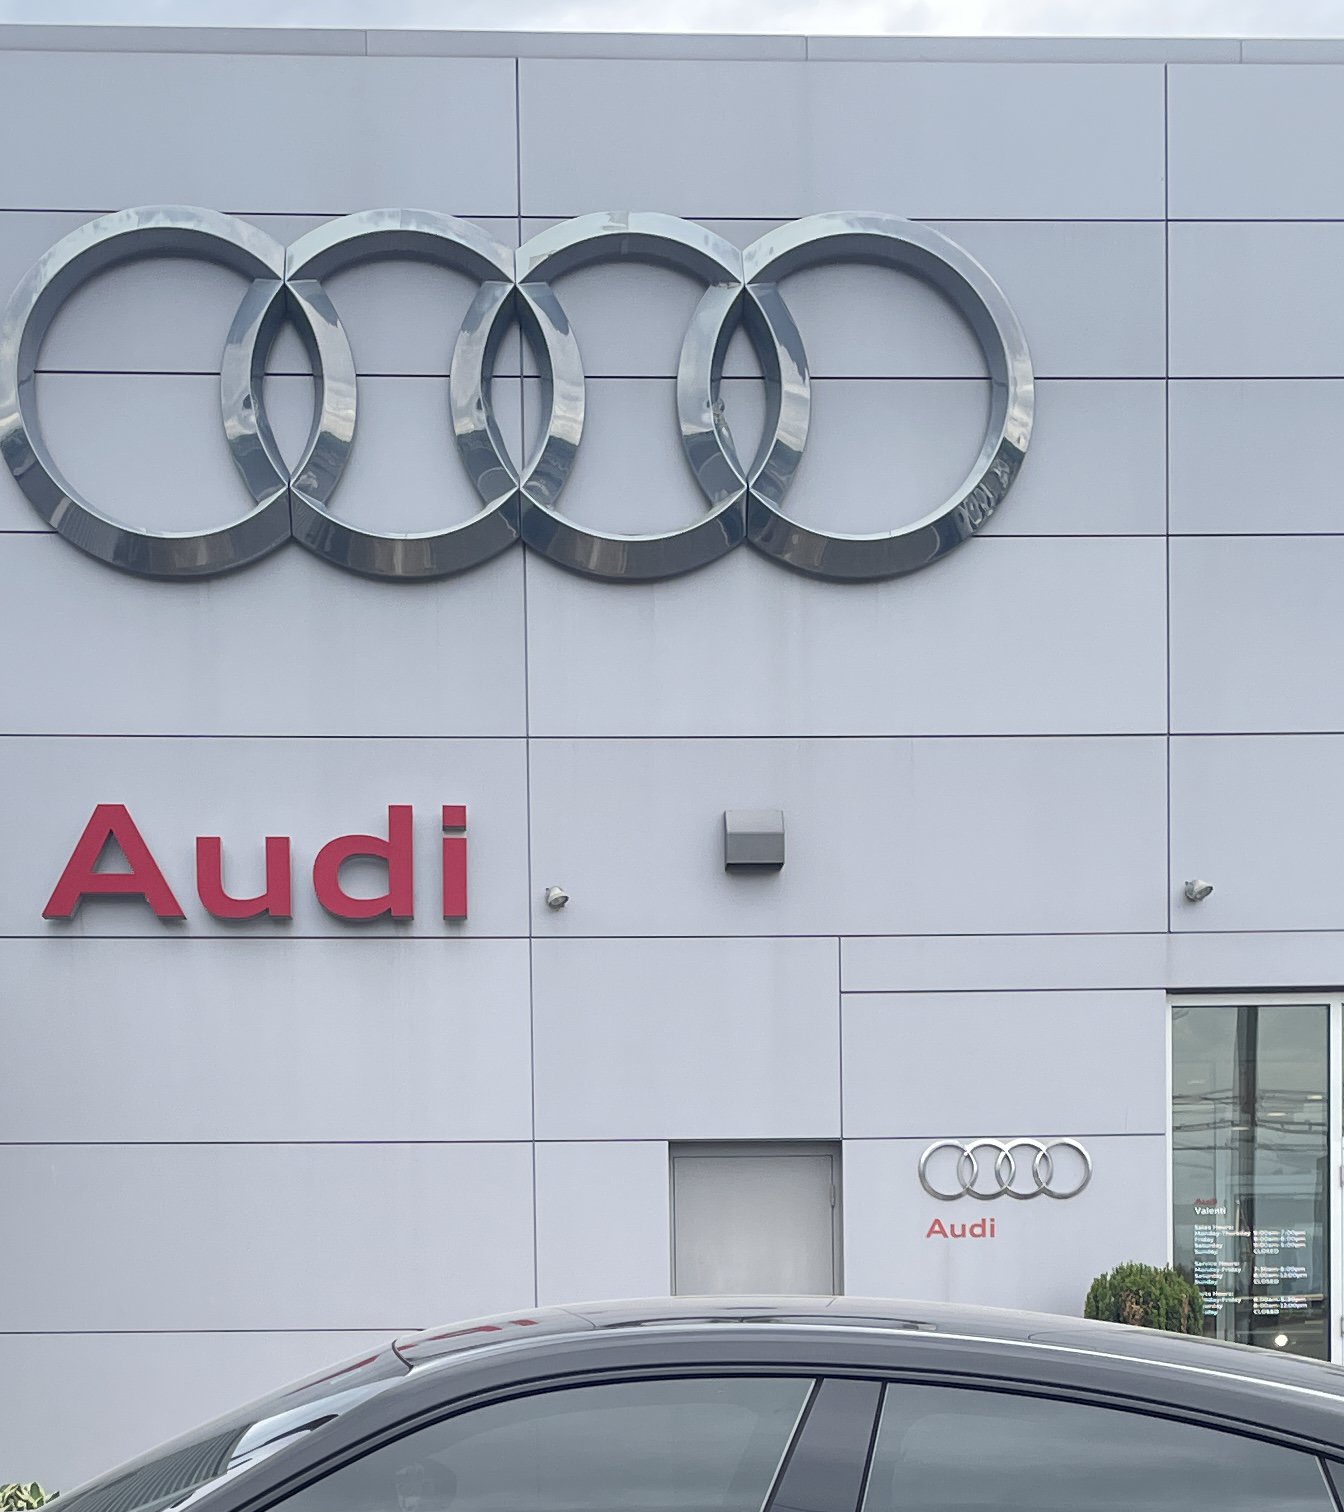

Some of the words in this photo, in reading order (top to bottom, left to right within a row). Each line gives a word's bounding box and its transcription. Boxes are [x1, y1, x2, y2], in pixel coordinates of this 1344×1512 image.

[42, 804, 467, 920] Audi
[1194, 1206, 1226, 1215] Valenti
[926, 1217, 995, 1238] Audi
